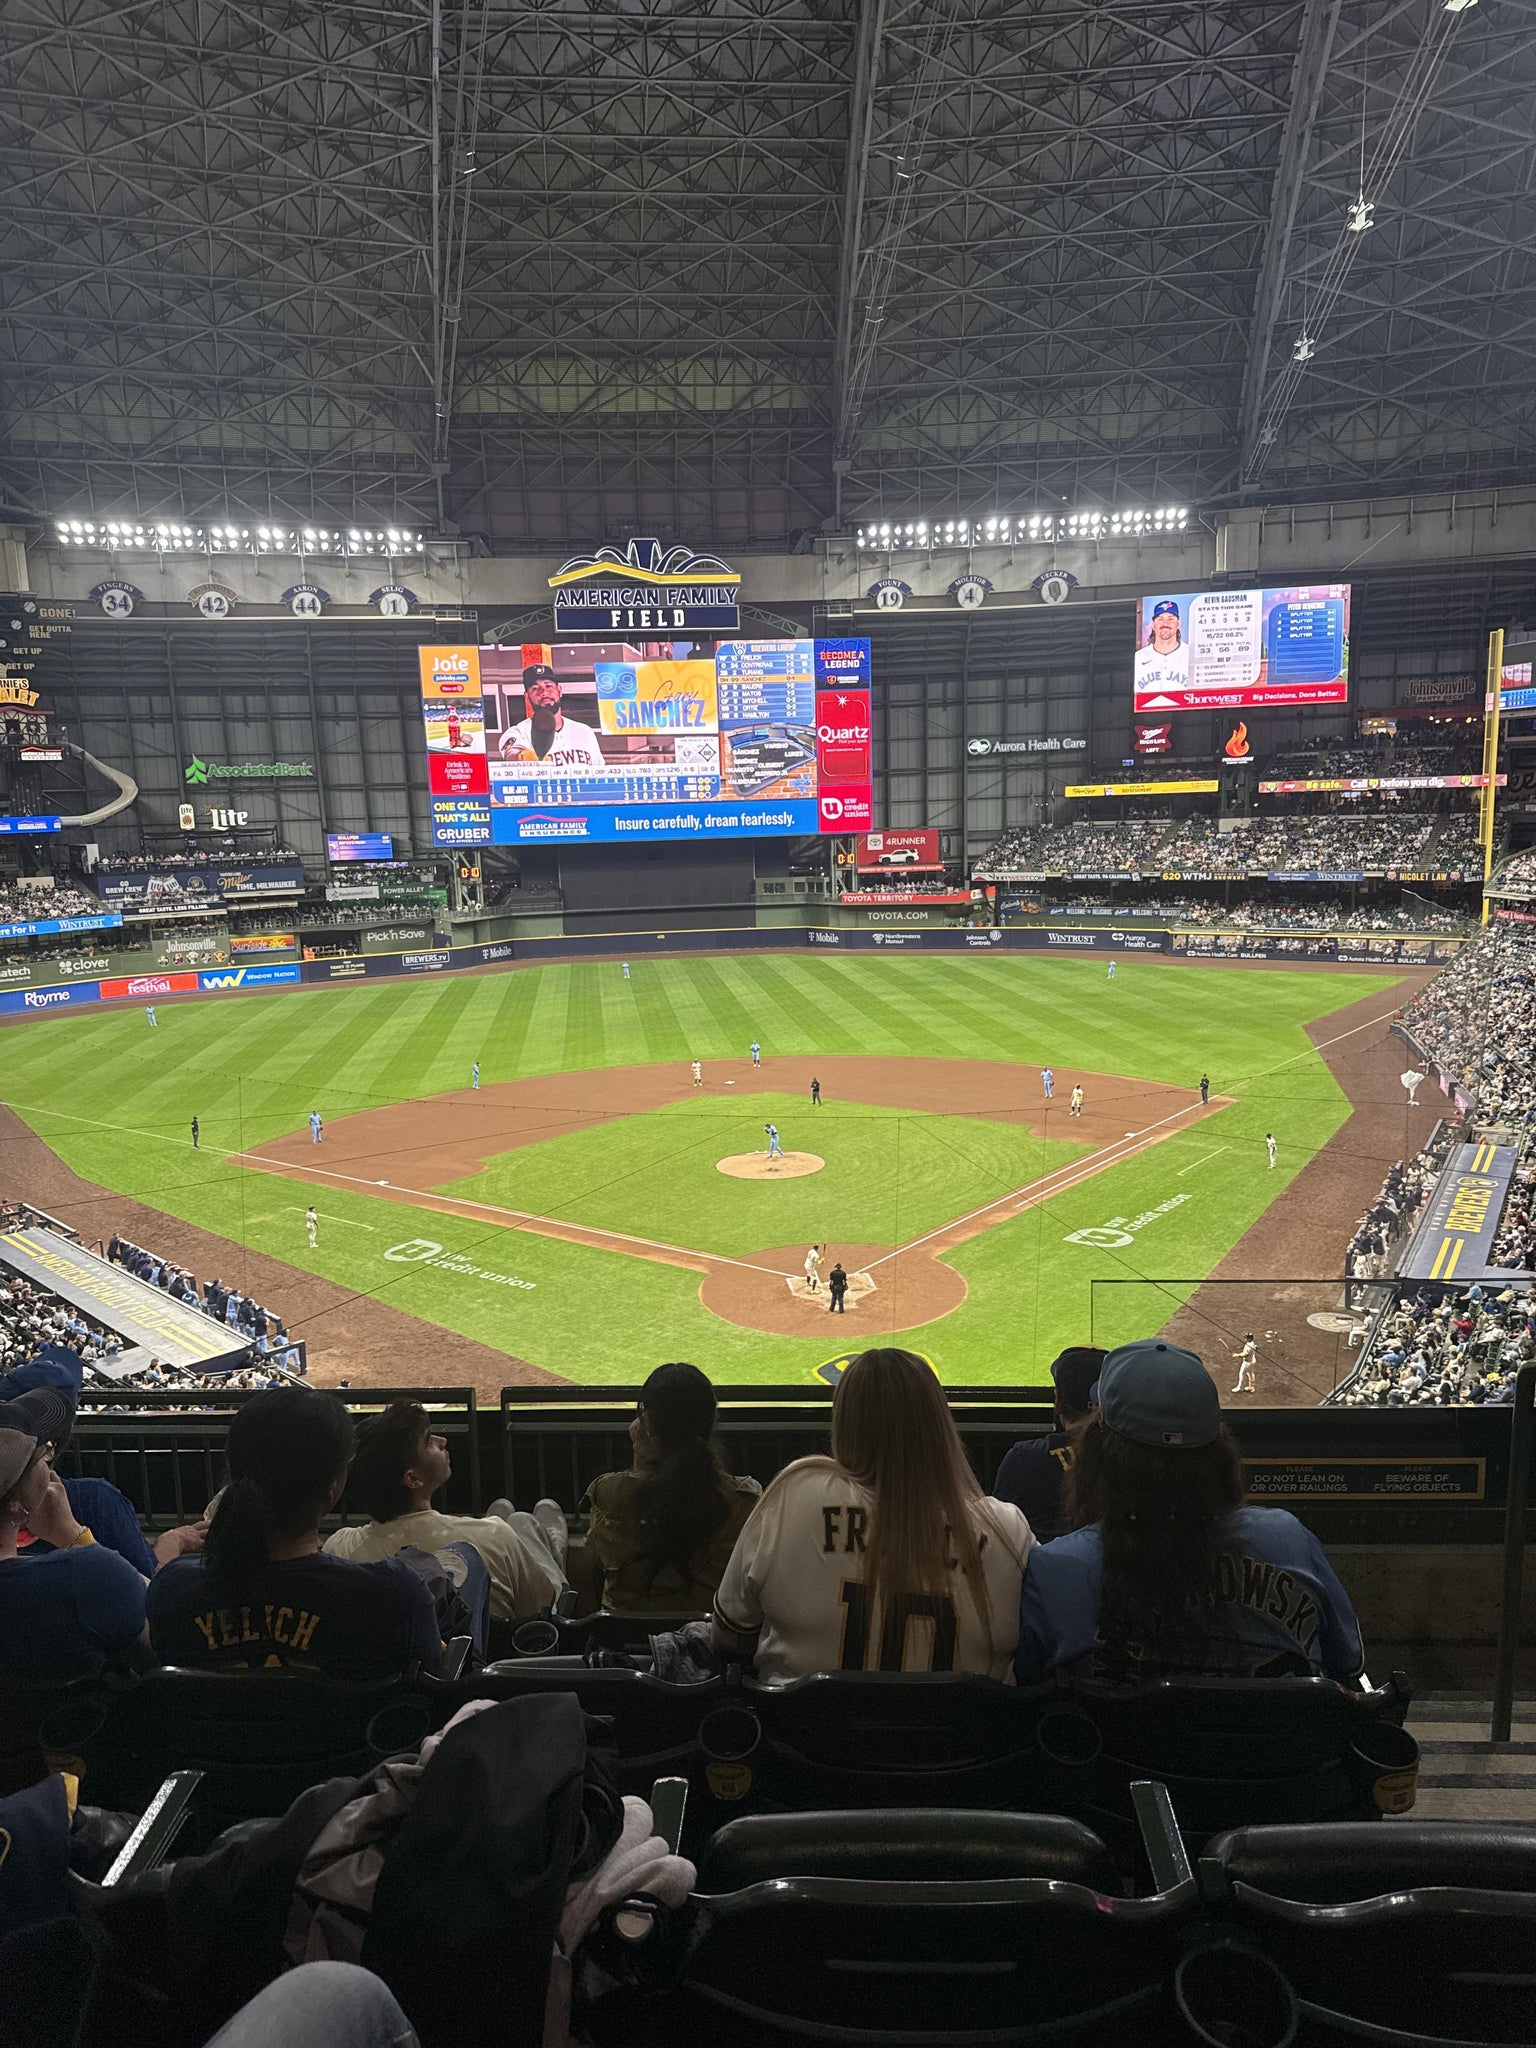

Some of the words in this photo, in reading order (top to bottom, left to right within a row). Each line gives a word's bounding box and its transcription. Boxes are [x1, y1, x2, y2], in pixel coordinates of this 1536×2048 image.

[954, 576, 986, 586] MOLITOR
[1041, 571, 1068, 580] UECKER
[98, 582, 135, 593] FINGERS
[878, 580, 902, 588] YOUNT
[555, 588, 660, 607] AMERICAN
[666, 587, 738, 606] FAMILY
[881, 592, 899, 607] 19
[965, 588, 974, 602] 4
[105, 595, 131, 612] 34
[202, 597, 225, 614] 42
[295, 598, 319, 614] 44
[391, 599, 400, 614] 1
[40, 608, 76, 618] GONE!
[611, 610, 686, 628] FIELD
[820, 651, 857, 660] BECOME
[858, 651, 865, 659] A
[432, 654, 469, 672] Joie
[825, 660, 860, 668] LEGEND
[597, 672, 638, 694] 99
[1406, 678, 1476, 697] Johnsonville
[1252, 693, 1263, 702] Big
[1264, 692, 1297, 701] Decisions,
[1317, 689, 1340, 697] Better.
[615, 700, 706, 728] SANCHEZ
[818, 725, 869, 743] Quartz
[992, 741, 1026, 753] Aurora
[1028, 738, 1060, 751] Health
[1062, 738, 1086, 749] Care
[1306, 781, 1318, 789] Be
[1320, 780, 1343, 789] safe.
[1350, 779, 1368, 789] Call
[1380, 778, 1409, 788] before
[1410, 779, 1427, 788] you
[1428, 777, 1446, 787] dig.
[434, 803, 456, 811] ONE
[211, 809, 248, 831] Lite
[434, 814, 468, 822] THAT'S
[470, 813, 490, 821] ALL!
[615, 817, 650, 830] Insure
[652, 815, 702, 831] carefully,
[704, 814, 738, 828] dream
[741, 811, 795, 828] fearlessly.
[437, 828, 490, 839] GRUBER
[886, 837, 926, 845] 4RUNNER
[217, 874, 253, 890] Miller
[1162, 872, 1181, 880] 620
[1182, 872, 1212, 880] WTMJ
[1316, 872, 1359, 880] WINTRUST
[1400, 872, 1429, 881] NICOLET
[1432, 872, 1447, 880] LAW
[256, 880, 296, 889] MILWAUKEE
[867, 912, 928, 920] TOYOTA.COM
[12, 926, 26, 934] For
[59, 918, 104, 930] WINTRUST
[366, 930, 389, 942] Pick
[399, 929, 425, 939] Save
[815, 932, 839, 943] Mobile
[1048, 933, 1096, 942] WINTRUST
[166, 938, 217, 953] Johnsonville
[489, 946, 512, 959] Mobile
[73, 958, 109, 971] clover
[24, 991, 70, 1008] Rhyme
[1154, 1193, 1193, 1212] union
[1444, 1187, 1493, 1233] BREWERS
[425, 1258, 481, 1275] credit
[479, 1270, 536, 1290] union
[121, 1304, 170, 1329] FIELD
[1254, 1475, 1270, 1483] DO
[1273, 1475, 1295, 1483] NOT
[1298, 1475, 1325, 1483] LEAN
[1386, 1475, 1433, 1483] BEWARE
[1250, 1484, 1266, 1492] OR
[1268, 1484, 1298, 1492] OVER
[1299, 1484, 1348, 1492] RAILINGS
[1374, 1484, 1410, 1492] FLYING
[1413, 1484, 1461, 1492] OBJECTS
[194, 1604, 321, 1651] YELICH
